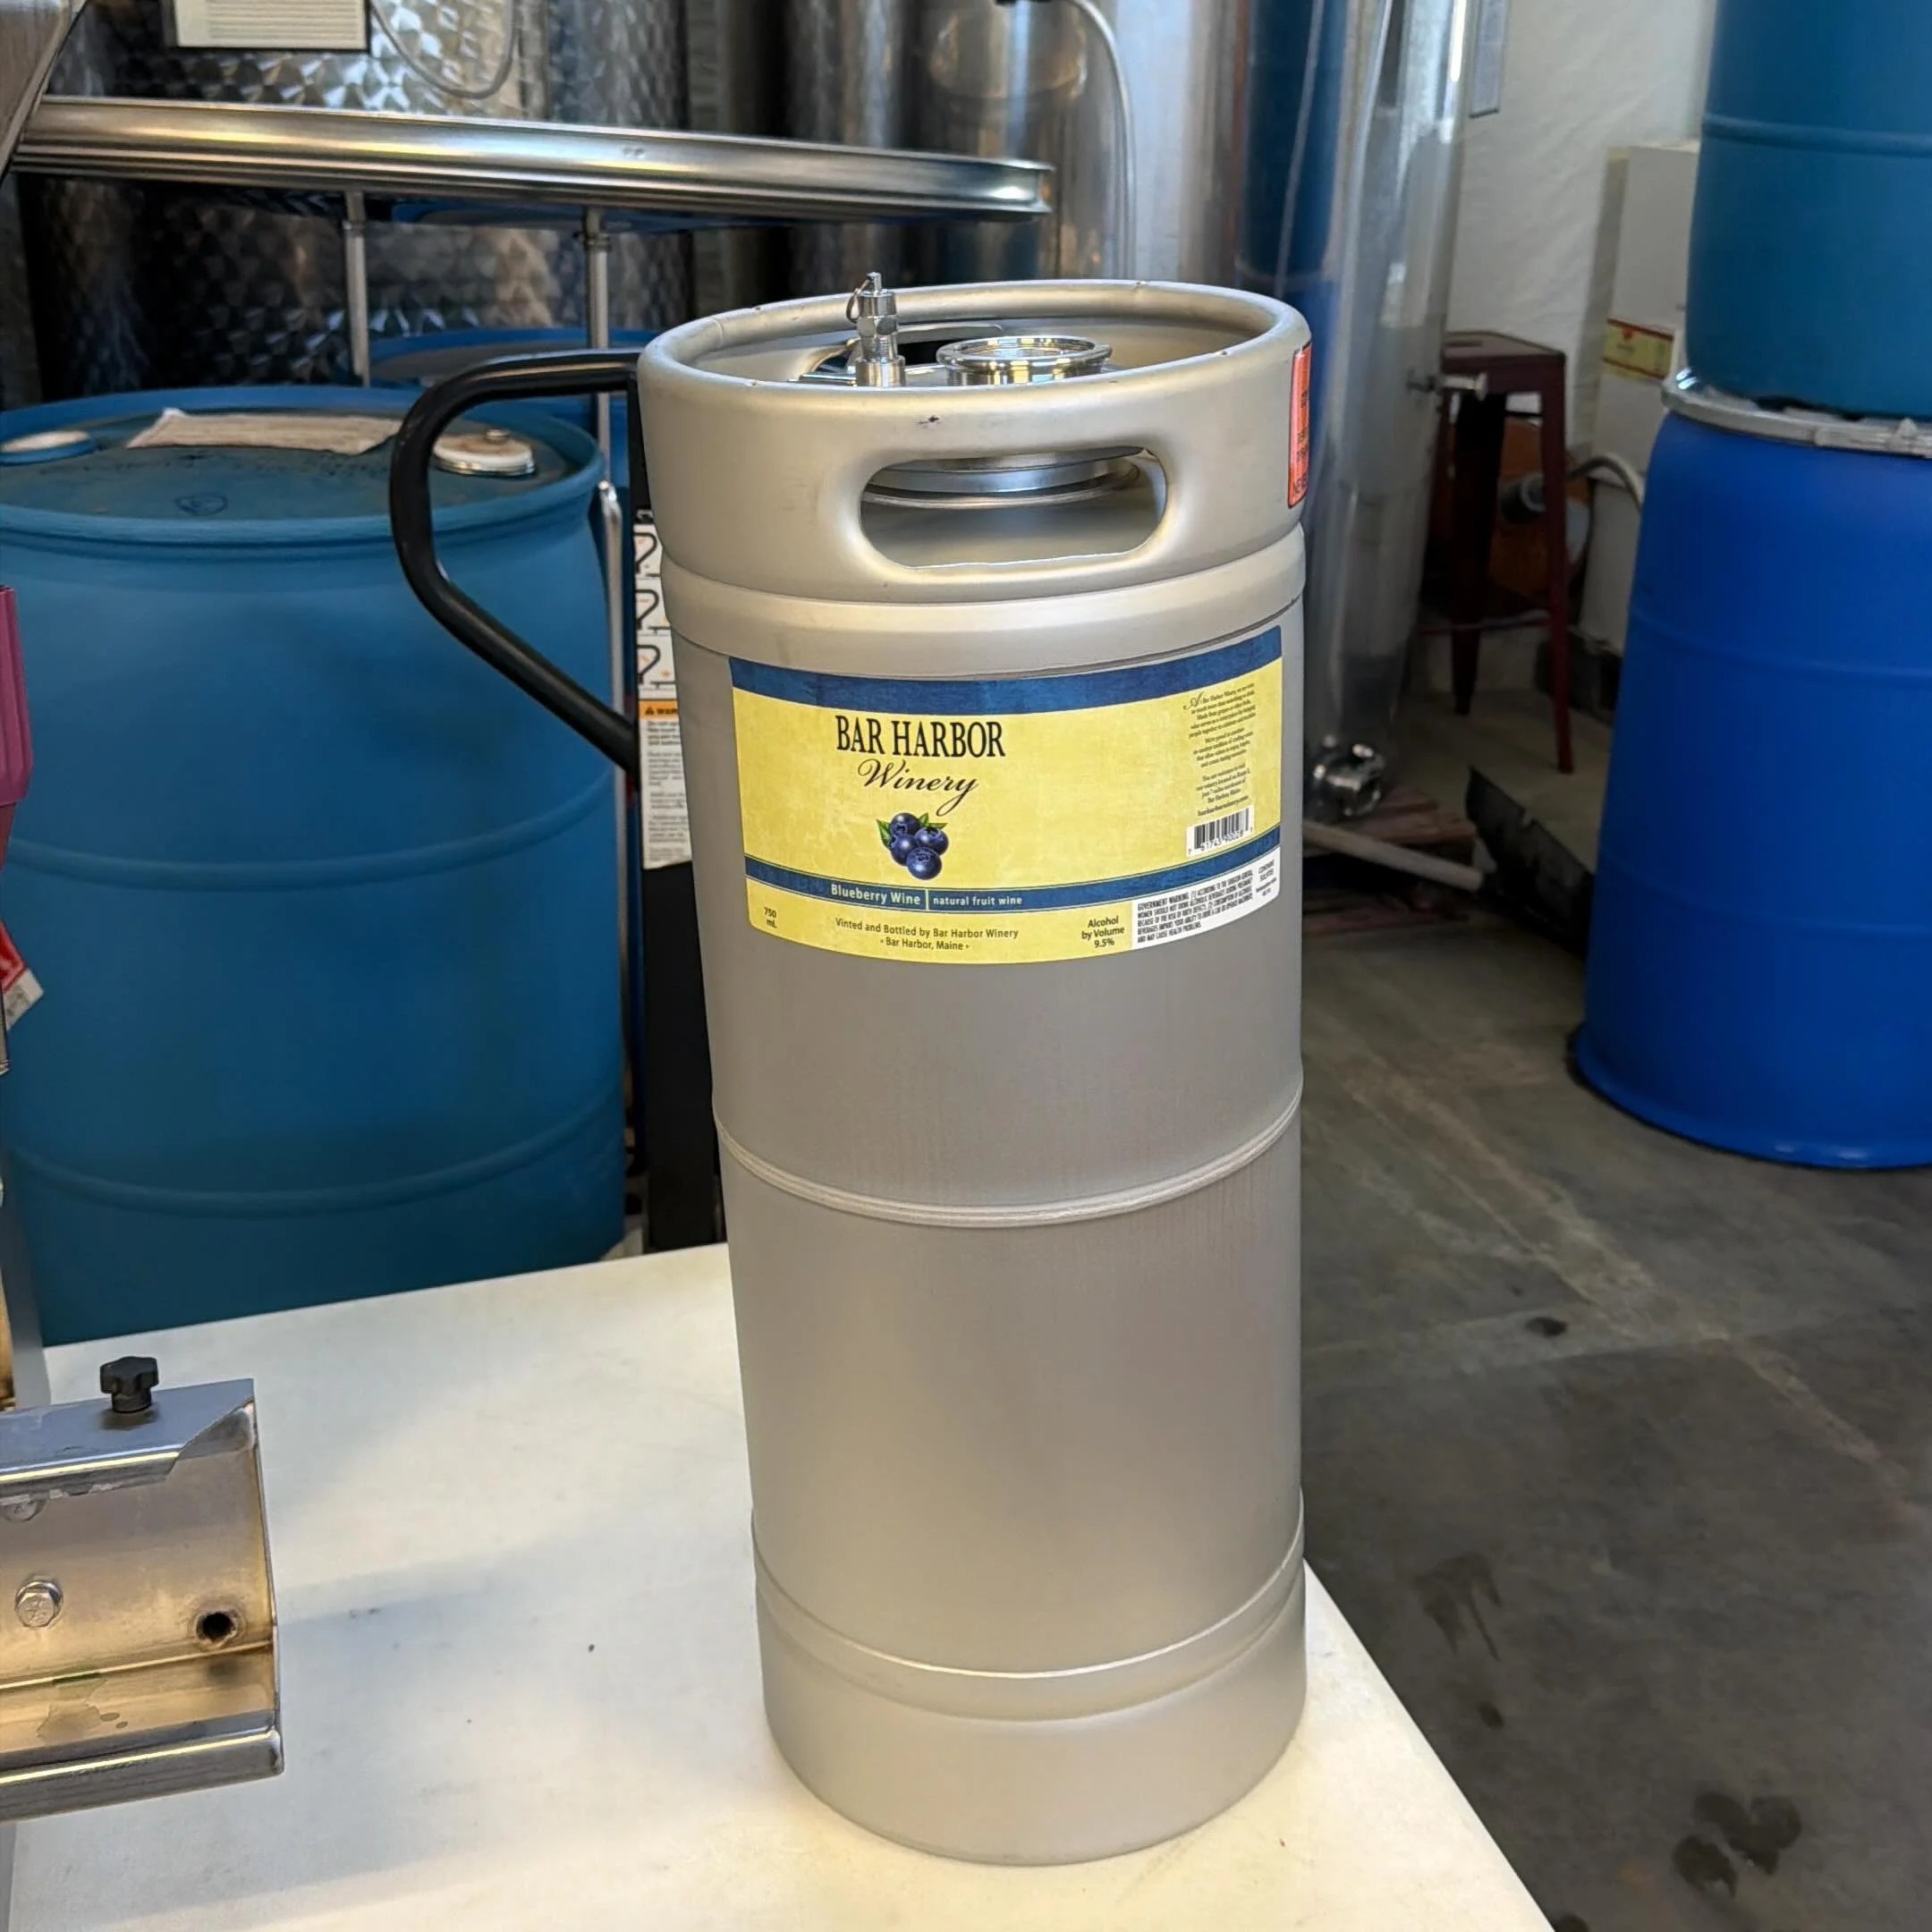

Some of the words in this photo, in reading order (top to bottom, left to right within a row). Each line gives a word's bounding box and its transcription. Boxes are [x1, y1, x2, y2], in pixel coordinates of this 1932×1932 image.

[835, 716, 886, 754] BAR
[891, 721, 1005, 758] HARBOR
[858, 758, 980, 817] Winery
[831, 884, 887, 905] Blueberry
[890, 893, 920, 905] Wine
[933, 895, 970, 905] natural
[972, 895, 996, 906] fruit
[998, 896, 1023, 905] wine
[835, 918, 863, 930] Vinted
[865, 922, 881, 933] and
[884, 924, 917, 936] Bottled
[919, 927, 930, 939] by
[933, 928, 948, 937] Bar
[951, 928, 983, 938] Harbor
[985, 928, 1019, 939] Winery
[1088, 915, 1120, 928] Alcohol
[1081, 930, 1092, 941] by
[1093, 927, 1125, 937] Volume
[886, 937, 900, 947] Bar
[902, 939, 935, 951] Harbor,
[936, 941, 963, 951] Maine
[1094, 937, 1115, 948] 9.5%
